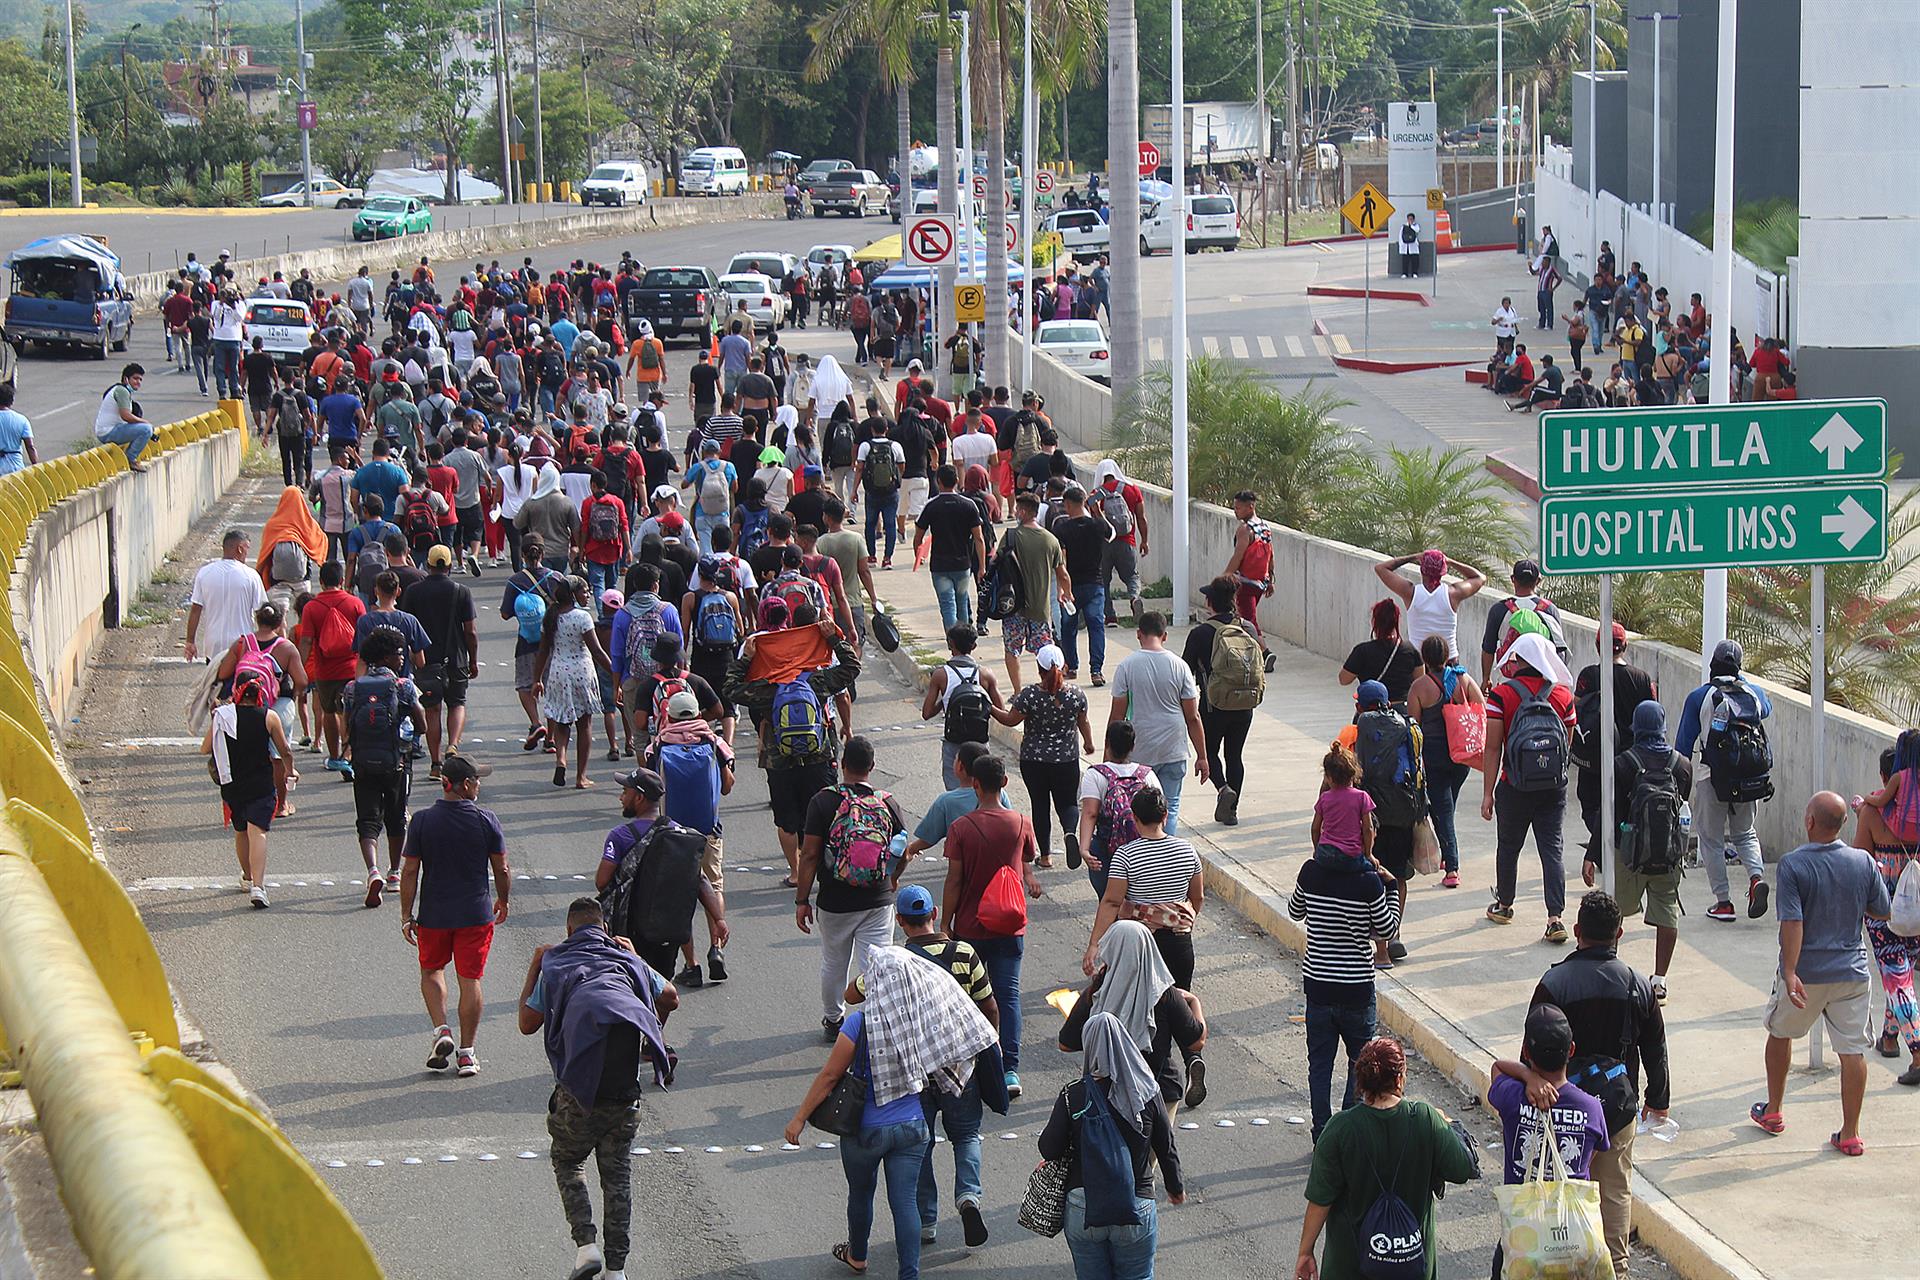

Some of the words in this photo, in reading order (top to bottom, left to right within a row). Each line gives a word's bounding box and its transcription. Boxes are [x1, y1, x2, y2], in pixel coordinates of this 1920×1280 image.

[1393, 133, 1433, 142] URGENCIAS
[1139, 151, 1157, 165] LTO
[920, 226, 944, 255] E
[287, 308, 304, 319] 1210
[320, 305, 327, 316] 8
[268, 327, 275, 337] 12
[281, 327, 289, 337] 10
[1562, 421, 1771, 473] HUIXTLA
[1551, 507, 1703, 557] HOSPITAL
[1727, 504, 1797, 552] IMSS
[1519, 1103, 1588, 1124] WATED:
